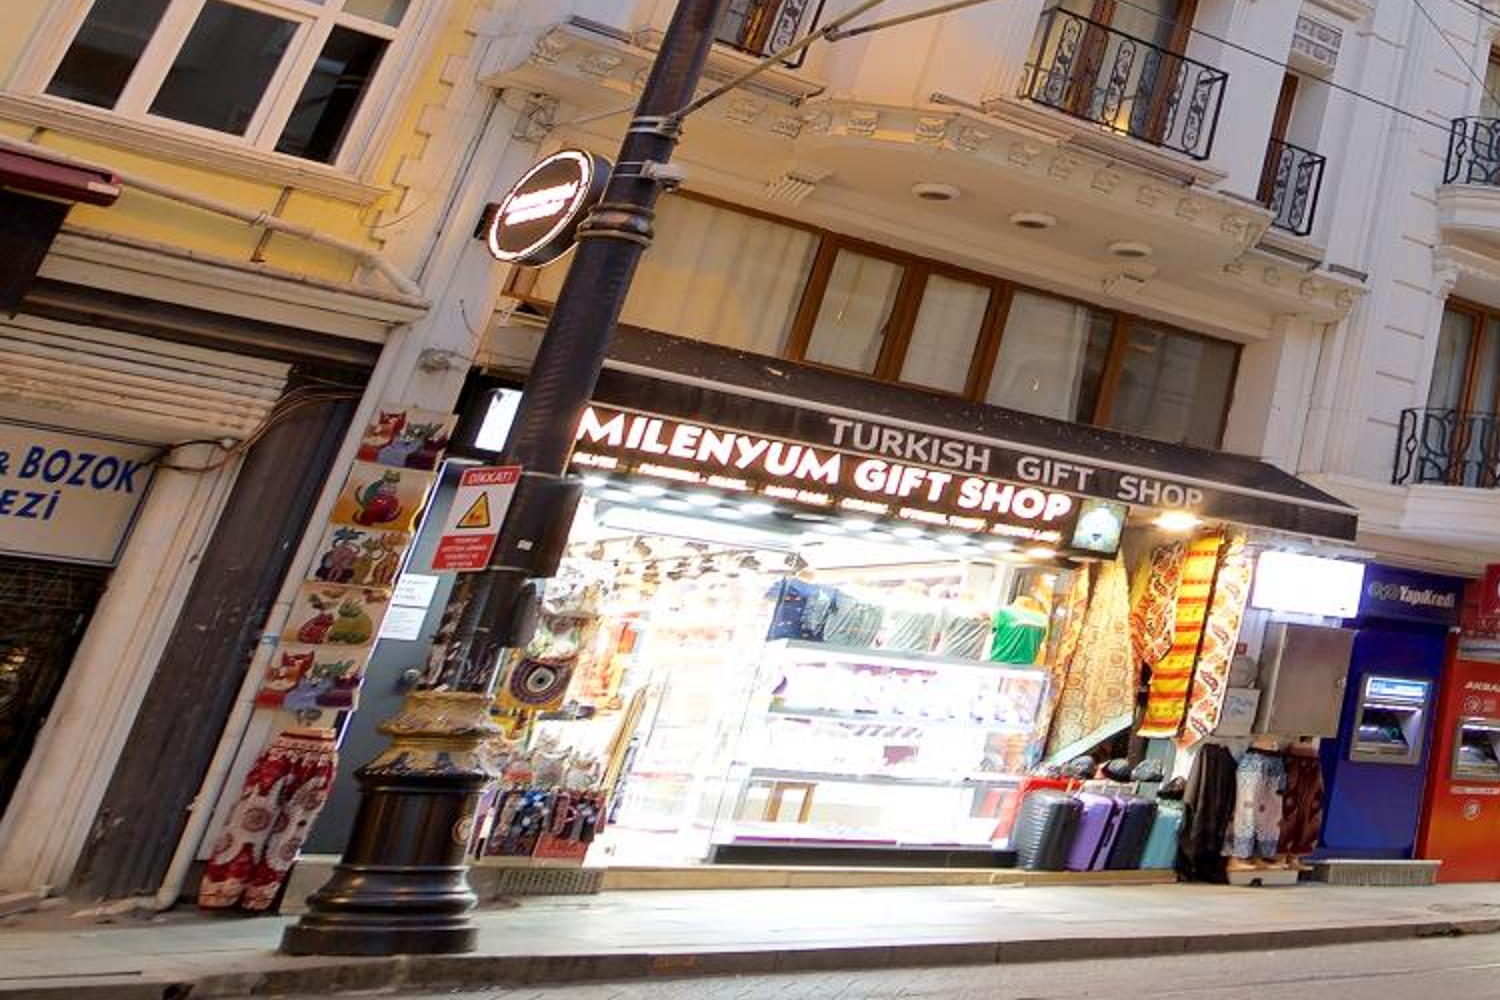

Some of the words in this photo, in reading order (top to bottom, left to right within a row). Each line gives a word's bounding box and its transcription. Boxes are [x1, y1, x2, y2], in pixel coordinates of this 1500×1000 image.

[18, 445, 141, 494] BOZOK
[576, 406, 841, 485] MILENYUM
[854, 459, 953, 503] GIFT
[957, 478, 1073, 523] SHOP
[827, 416, 992, 473] TURKISH
[1017, 456, 1096, 491] GIFT
[1117, 475, 1203, 509] SHOP
[0, 490, 61, 520] EZİ
